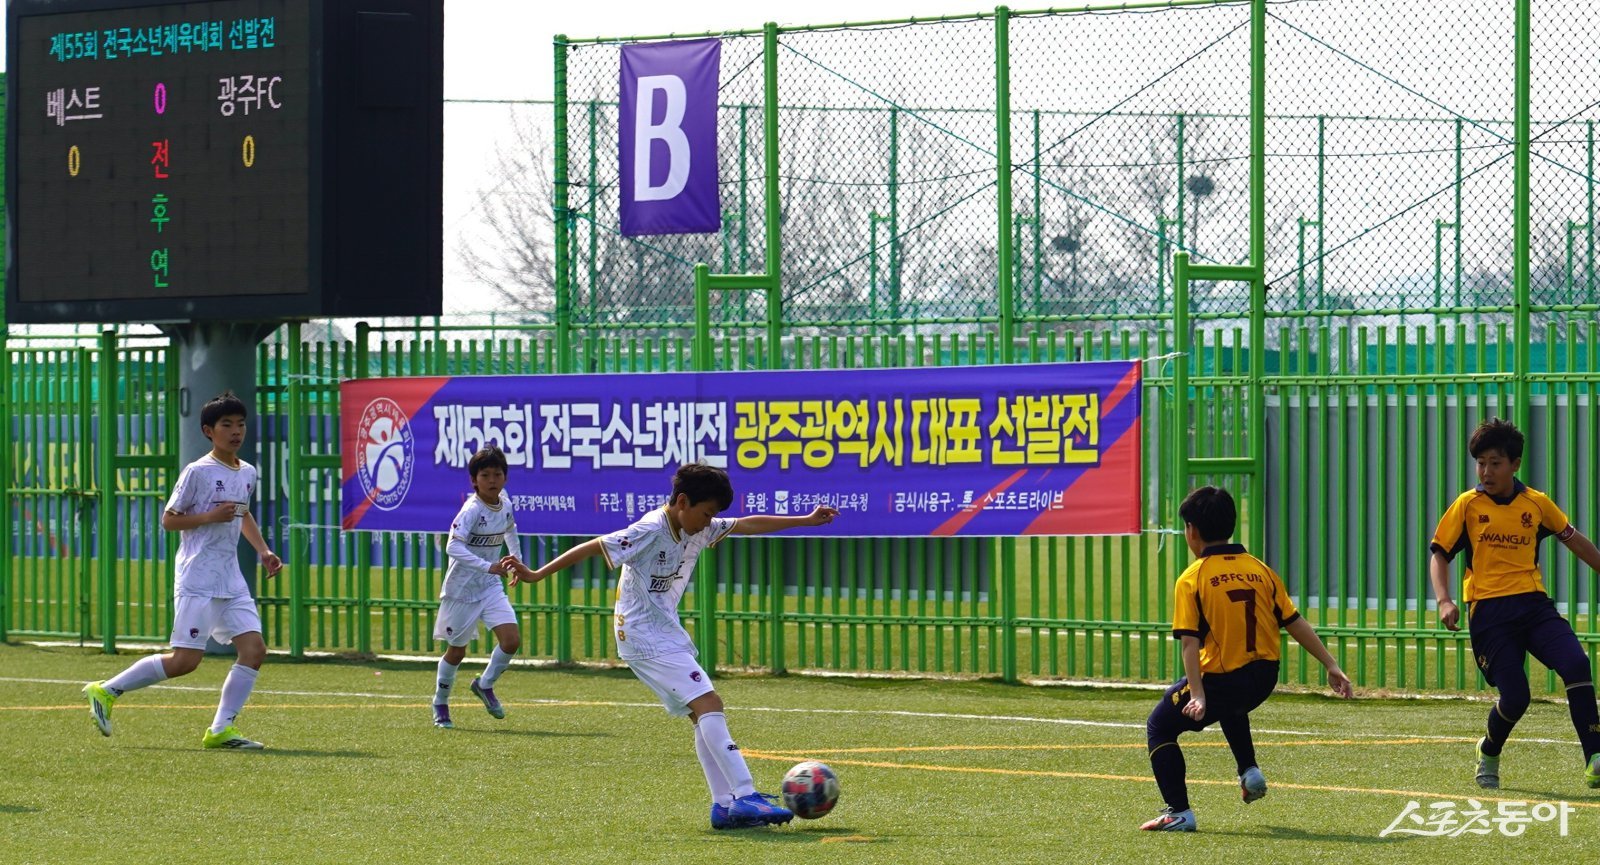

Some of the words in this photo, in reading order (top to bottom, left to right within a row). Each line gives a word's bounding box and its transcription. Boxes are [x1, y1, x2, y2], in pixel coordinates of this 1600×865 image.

[49, 30, 98, 62] 제55회
[103, 20, 223, 59] 전국소년체육대회
[228, 17, 275, 49] 선발전
[47, 87, 103, 126] 베스트
[154, 83, 166, 114] 0
[217, 75, 282, 116] 광주FC
[243, 135, 255, 167] 0
[634, 74, 691, 202] B
[68, 145, 80, 177] 0
[151, 139, 169, 179] 전
[151, 193, 170, 233] 후
[151, 248, 169, 288] 연
[433, 404, 534, 468] 제55회
[540, 402, 728, 469] 전국소년체전
[734, 398, 903, 469] 광주광역시
[911, 397, 981, 466] 대표
[989, 393, 1100, 465] 선발전
[599, 492, 623, 513] 주관:
[746, 492, 769, 513] 후원:
[792, 493, 869, 513] 광주광역시교육청
[895, 491, 955, 513] 공식사용구:
[983, 490, 1064, 511] 스포츠트라이브
[1209, 573, 1244, 587] 광주FC
[1225, 588, 1258, 653] 7
